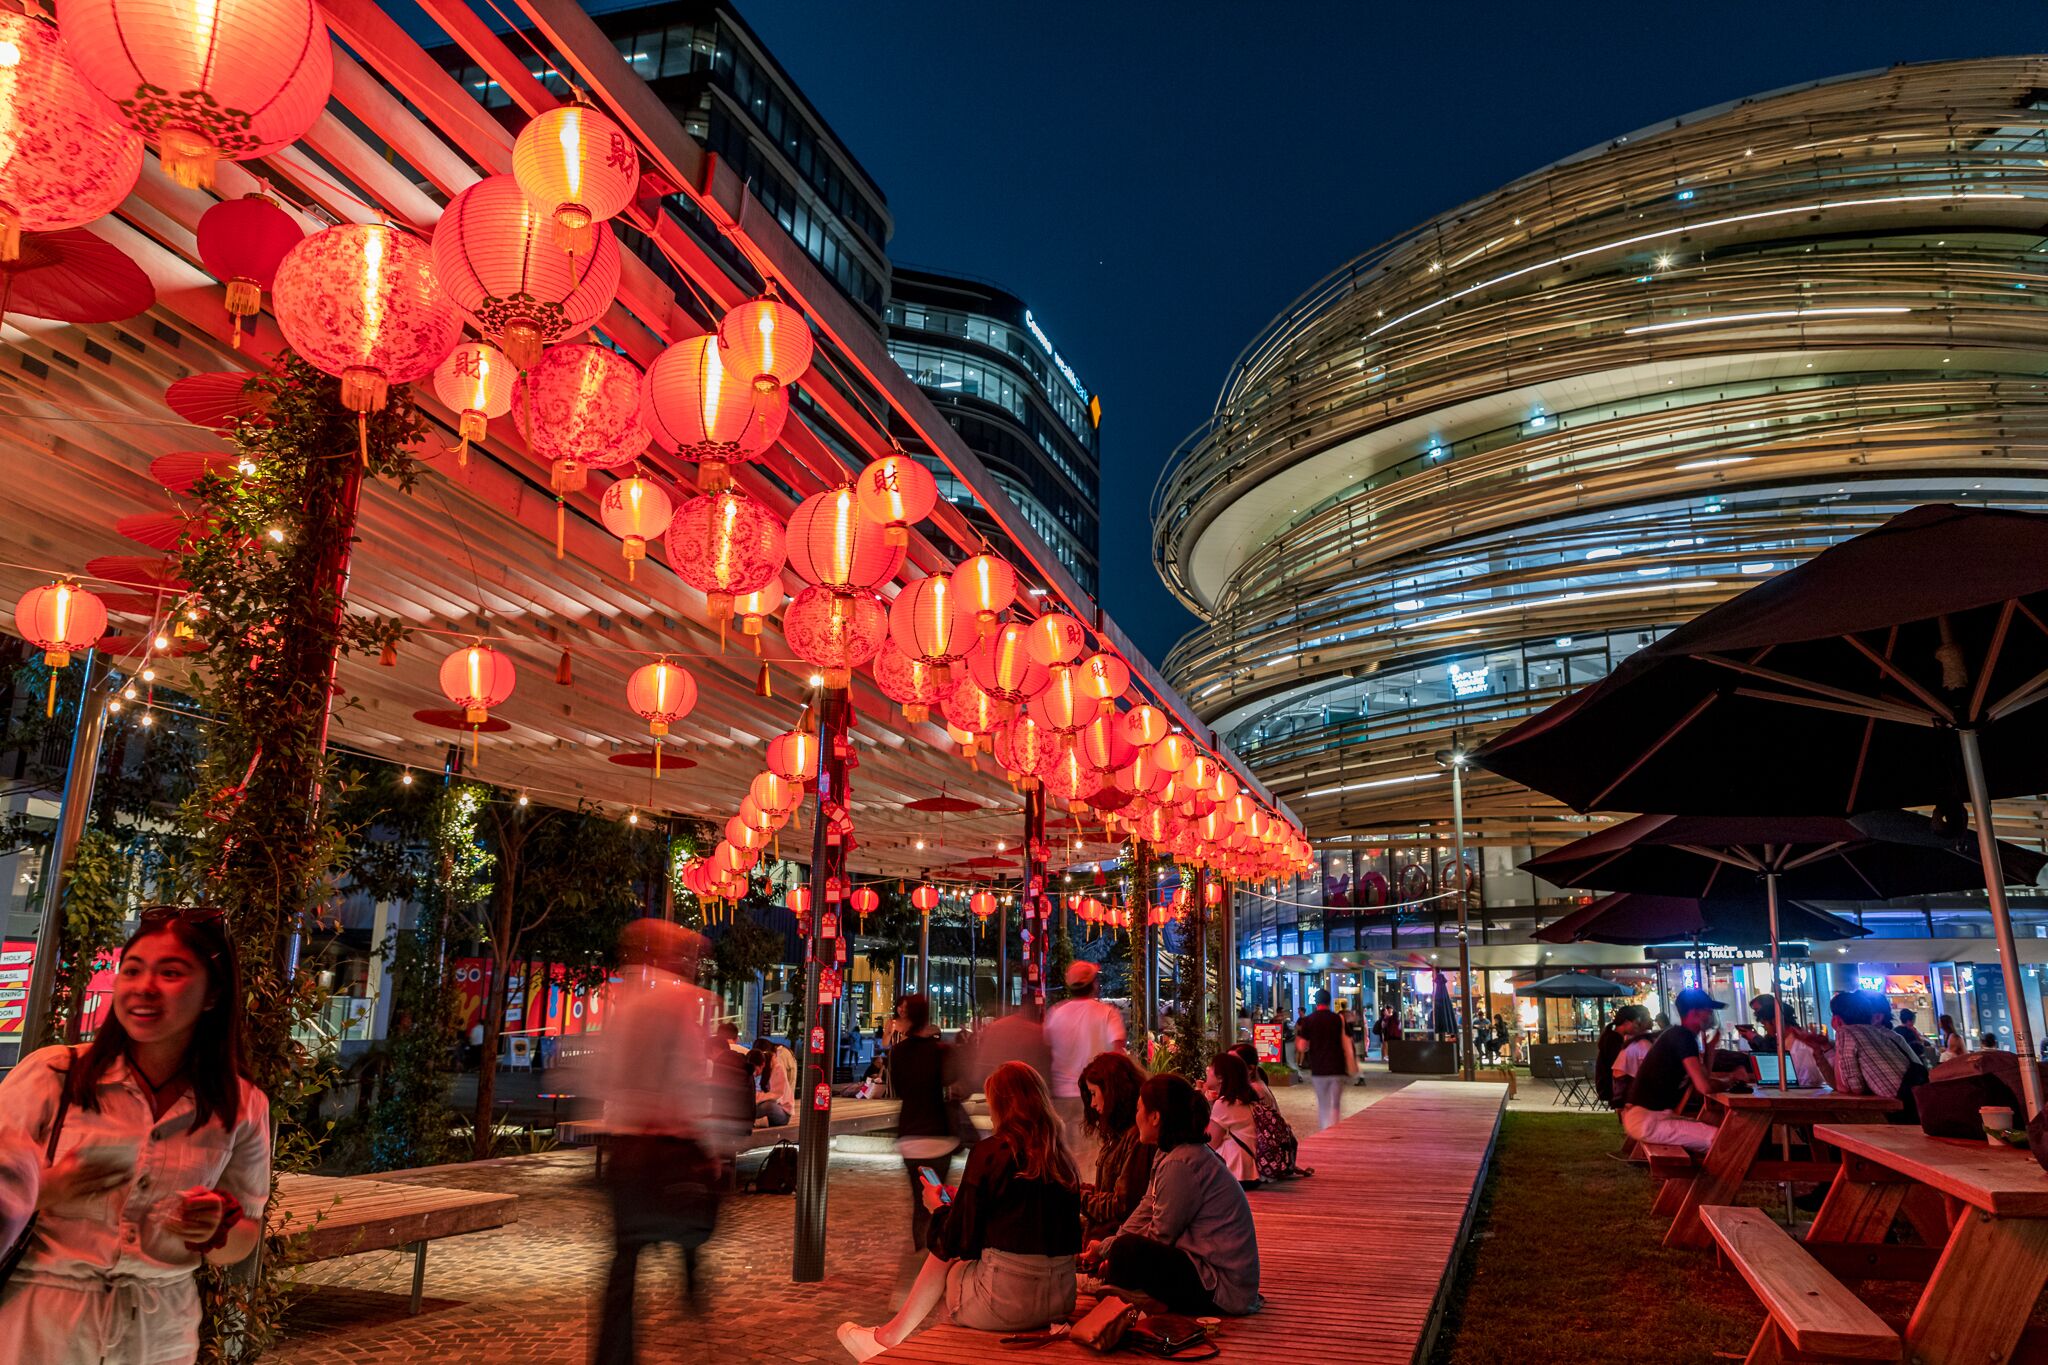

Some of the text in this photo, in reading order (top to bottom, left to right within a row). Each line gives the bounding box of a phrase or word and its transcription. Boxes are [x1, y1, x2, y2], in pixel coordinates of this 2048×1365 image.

[453, 351, 482, 380] 財
[874, 464, 899, 495] 財
[605, 484, 623, 513] 財
[1685, 950, 1710, 959] FOOD
[1711, 950, 1735, 959] HALL
[1744, 950, 1764, 958] BAR
